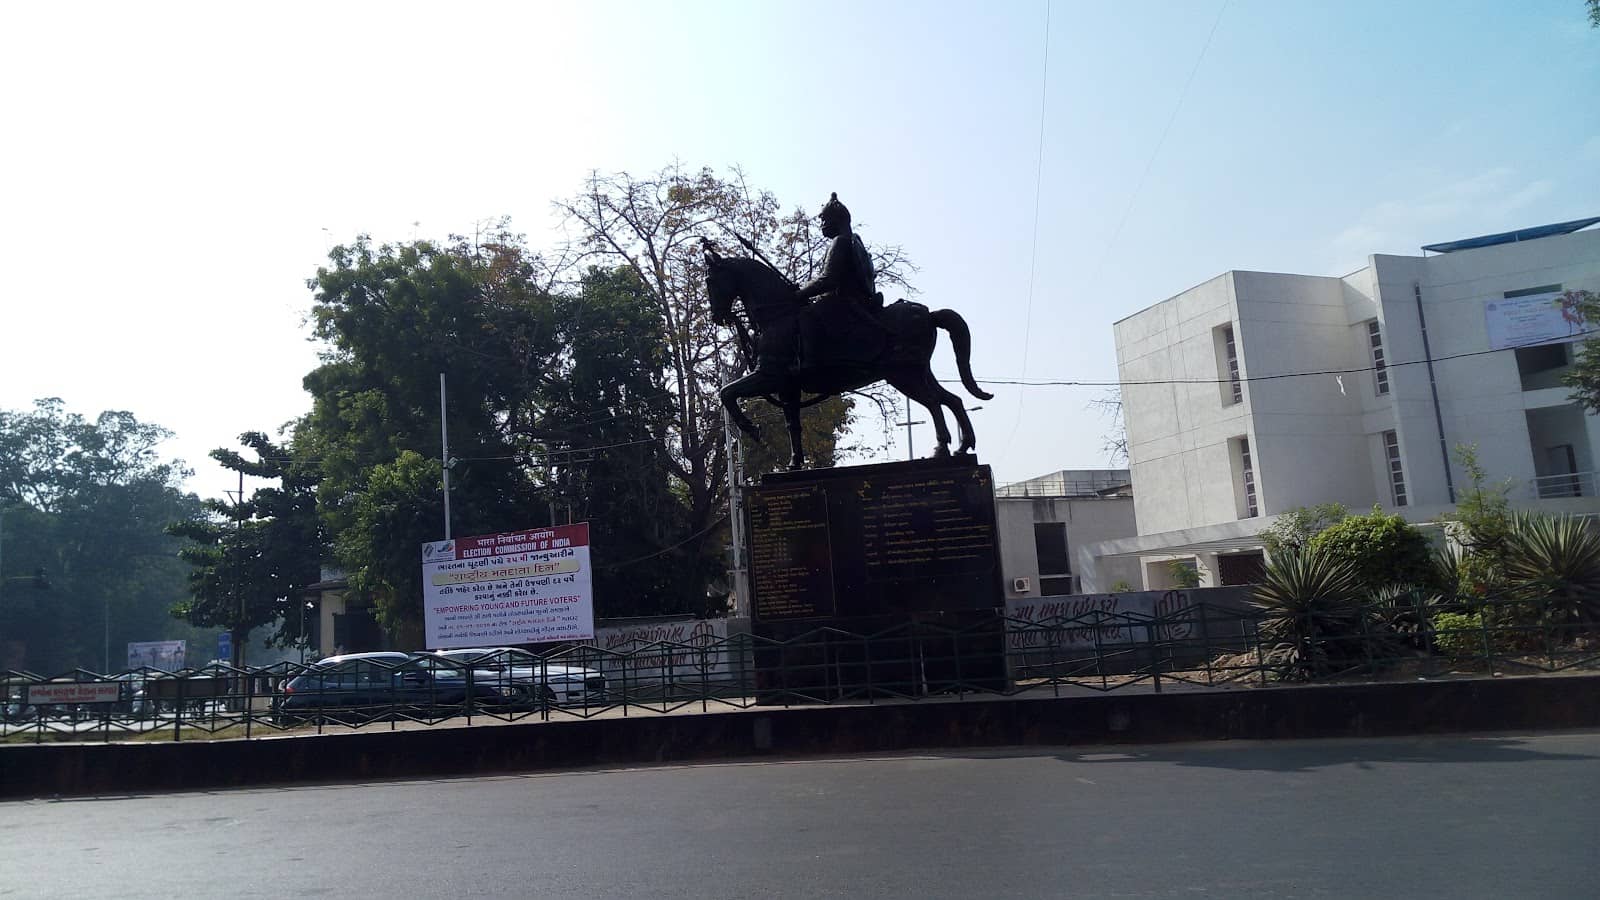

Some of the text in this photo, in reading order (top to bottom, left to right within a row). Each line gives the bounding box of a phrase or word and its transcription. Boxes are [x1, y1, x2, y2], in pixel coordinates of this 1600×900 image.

[463, 547, 492, 558] ELECTION
[495, 542, 536, 555] COMMISSION
[540, 541, 549, 550] OF
[552, 537, 571, 548] INDIA
[481, 602, 505, 611] YOUNG
[505, 600, 520, 608] AND
[520, 599, 548, 607] FUTURE
